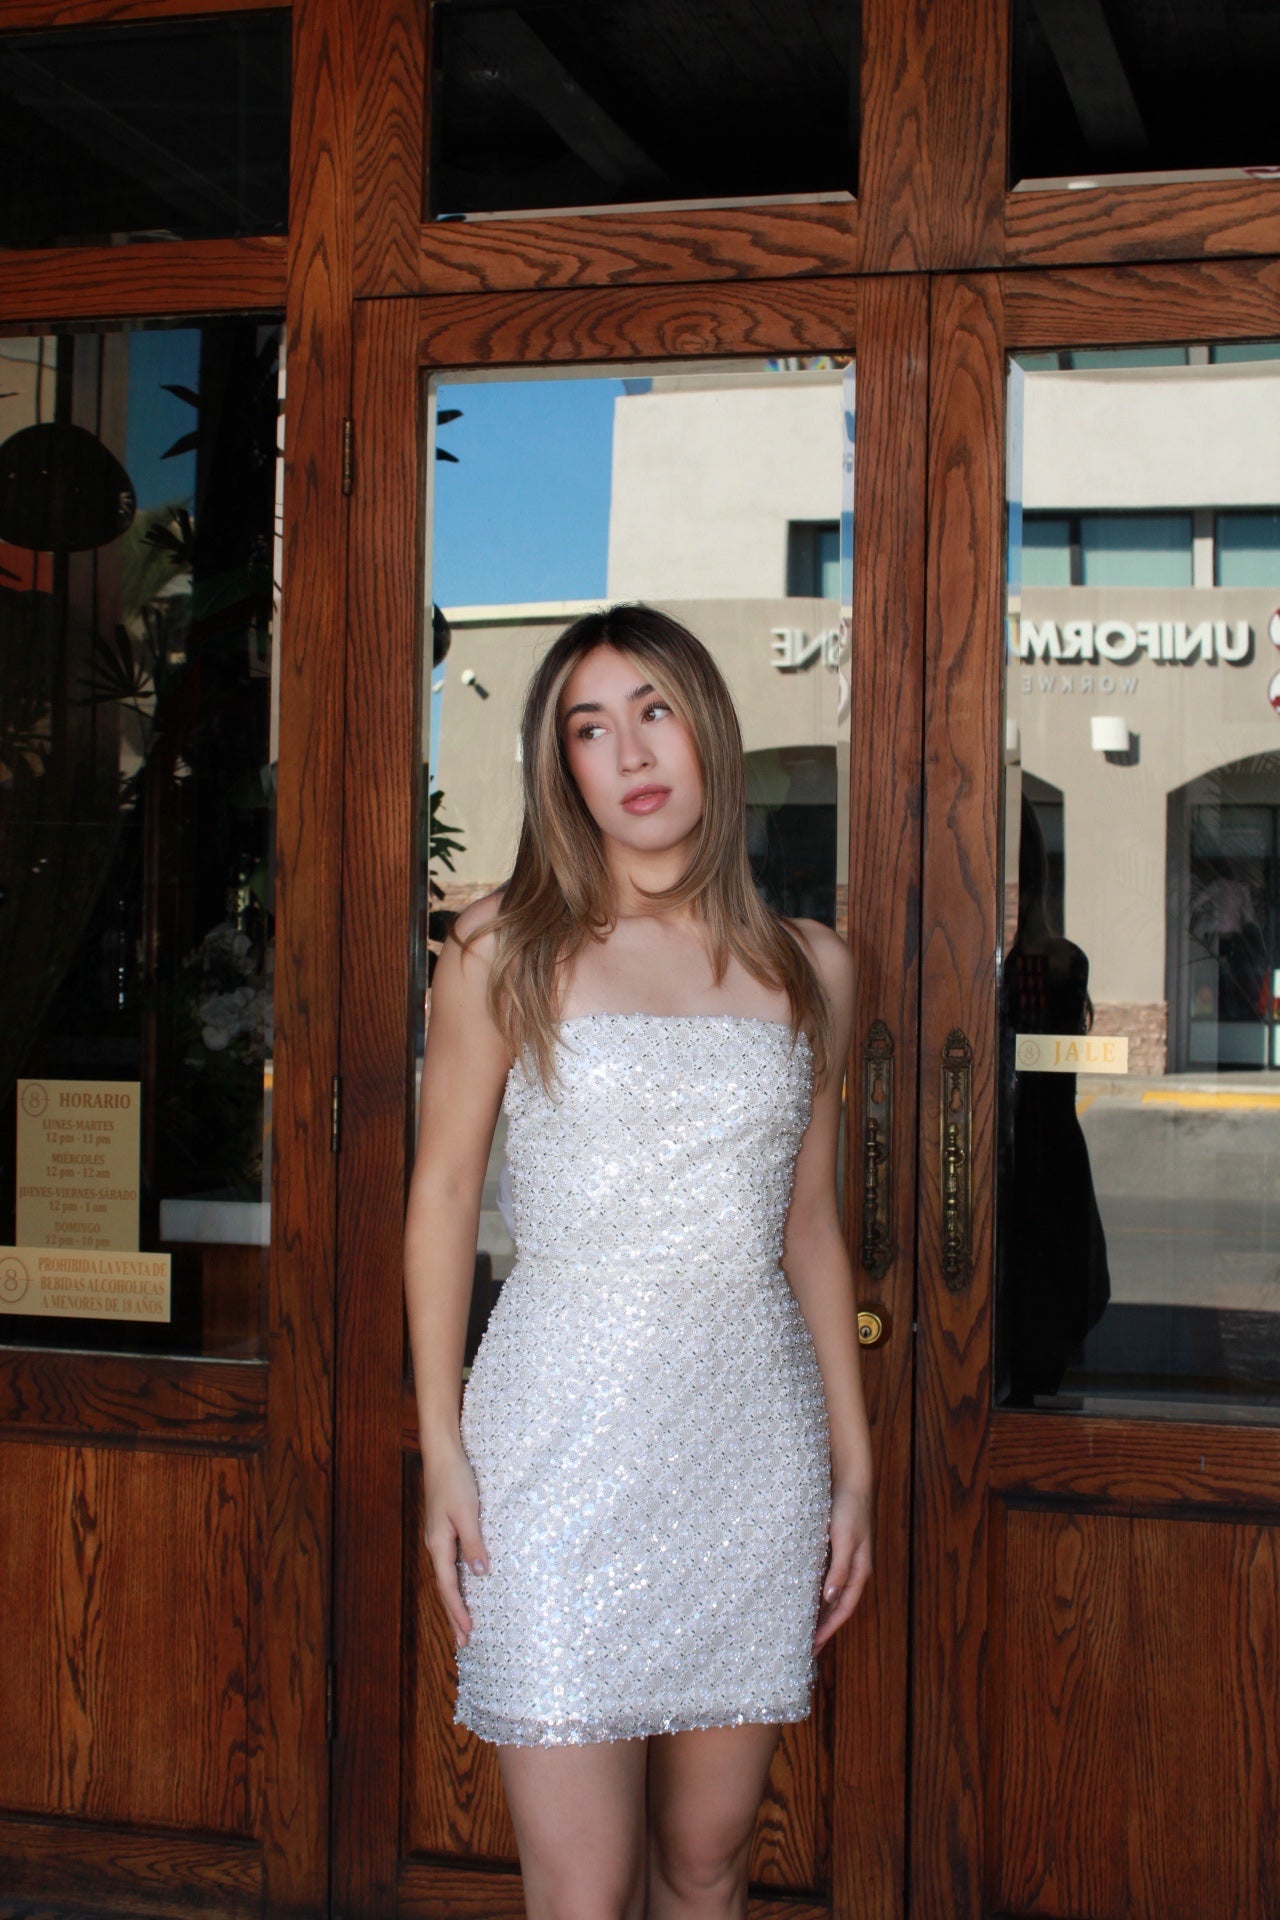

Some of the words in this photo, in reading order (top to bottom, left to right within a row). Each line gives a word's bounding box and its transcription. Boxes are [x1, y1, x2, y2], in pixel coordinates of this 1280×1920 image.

[1053, 1040, 1116, 1066] JALE
[59, 1092, 131, 1109] HORARIO
[42, 1118, 115, 1131] LUNES-MARTES
[46, 1132, 57, 1143] 12
[59, 1134, 75, 1145] pm
[83, 1133, 93, 1144] 11
[95, 1135, 111, 1147] pm
[46, 1166, 57, 1177] 12
[59, 1169, 75, 1179] pm
[83, 1167, 95, 1178] 12
[96, 1170, 111, 1179] am
[48, 1200, 59, 1211] 12
[62, 1203, 77, 1213] pm
[54, 1221, 102, 1233] DOMINGO
[95, 1238, 111, 1248] pm
[38, 1256, 97, 1274] PROHIBIDA
[98, 1259, 113, 1275] LA
[112, 1260, 151, 1276] VENTA
[152, 1262, 168, 1278] DE
[4, 1268, 18, 1291] 8
[40, 1275, 86, 1292] BEBIDAS
[42, 1295, 49, 1309] A
[49, 1294, 103, 1311] MENORES
[104, 1297, 120, 1312] DE
[122, 1298, 133, 1313] 18
[135, 1296, 164, 1314] AÑOS
